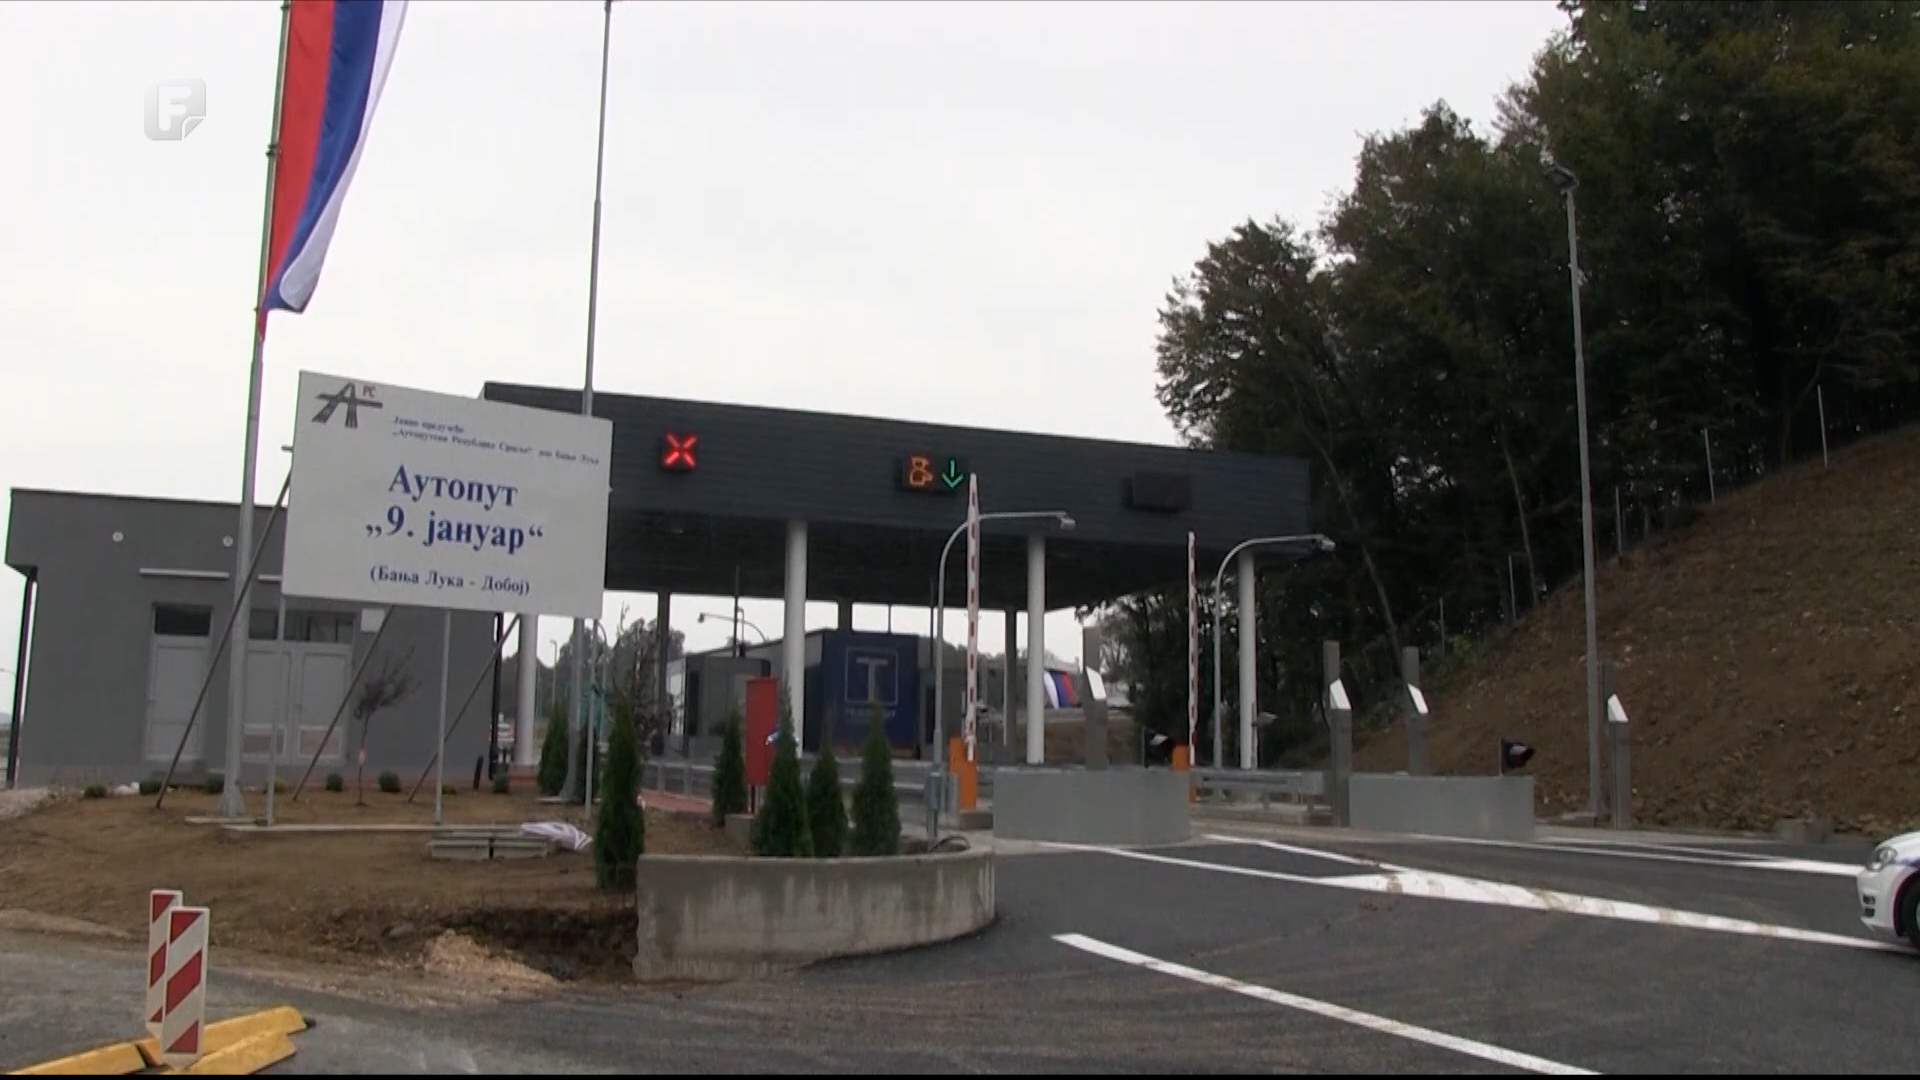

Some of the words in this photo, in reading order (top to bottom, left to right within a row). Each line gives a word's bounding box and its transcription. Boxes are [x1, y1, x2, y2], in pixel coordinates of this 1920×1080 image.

[388, 464, 519, 511] Аутопут
[365, 506, 415, 540] „9.
[422, 511, 544, 555] јануар“
[370, 565, 420, 586] (Бања
[424, 570, 465, 588] Лука
[481, 575, 530, 596] Добој)
